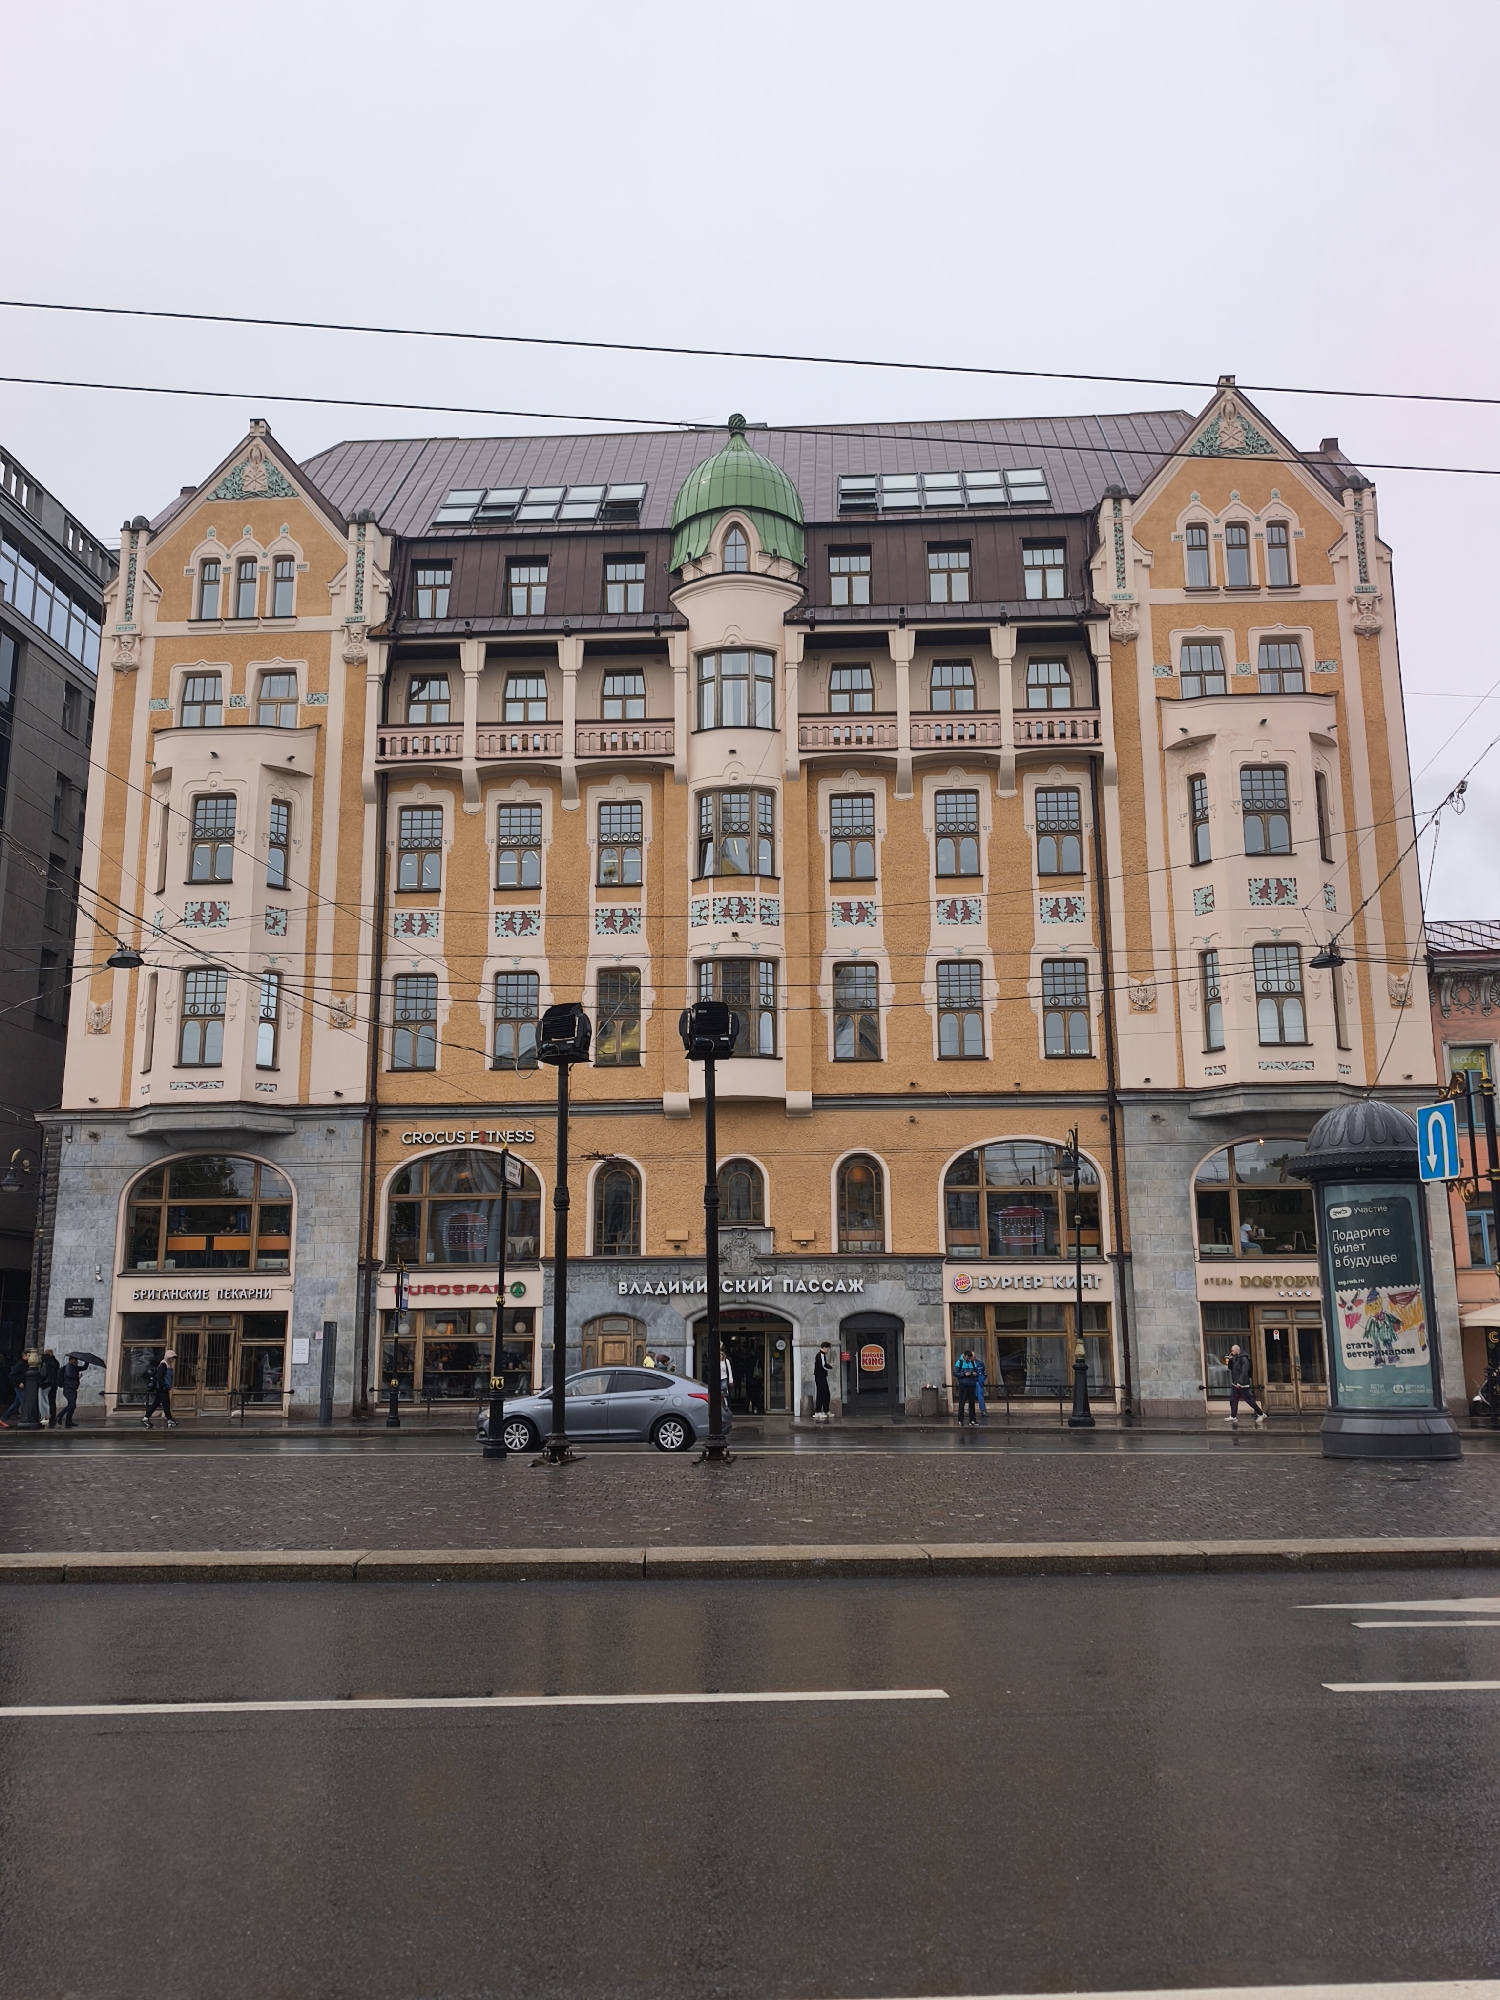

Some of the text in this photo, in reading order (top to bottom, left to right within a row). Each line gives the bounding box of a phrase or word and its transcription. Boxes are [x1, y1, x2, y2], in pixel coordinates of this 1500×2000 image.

[1453, 1056, 1483, 1064] HOTEL
[401, 1129, 535, 1145] CROCUS FITNESS
[1353, 1205, 1388, 1214] Участие
[1332, 1228, 1390, 1242] Подарите
[1333, 1243, 1366, 1255] билет
[1335, 1254, 1398, 1269] в будущее
[618, 1276, 865, 1295] ВЛАДИМИСКИЙ ПАССАЖ
[978, 1275, 1103, 1290] БУРГЕР КИНГ
[1204, 1277, 1233, 1286] ОТЕЛЬ
[131, 1289, 273, 1301] БРИТАНСКИЕ ПЕКАРНИ
[394, 1284, 507, 1296] UROSPAR
[1345, 1341, 1373, 1350] стать
[1346, 1347, 1416, 1359] ветеринаром
[862, 1358, 884, 1366] KING
